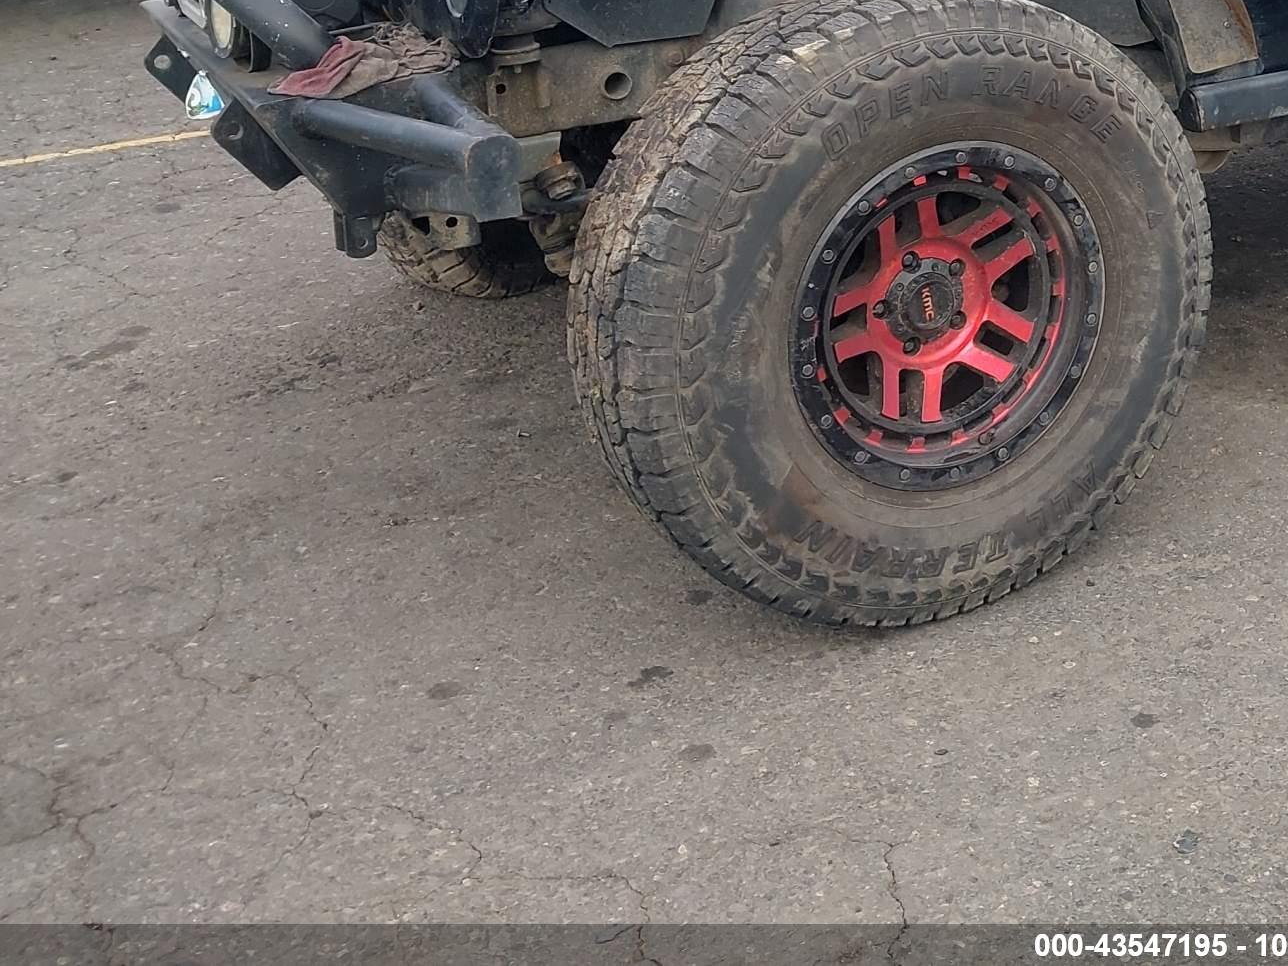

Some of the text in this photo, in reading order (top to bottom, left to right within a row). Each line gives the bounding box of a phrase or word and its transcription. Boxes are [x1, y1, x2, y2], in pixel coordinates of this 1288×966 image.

[820, 64, 1123, 162] OPEN RANGE
[792, 519, 1010, 580] TERRAIN
